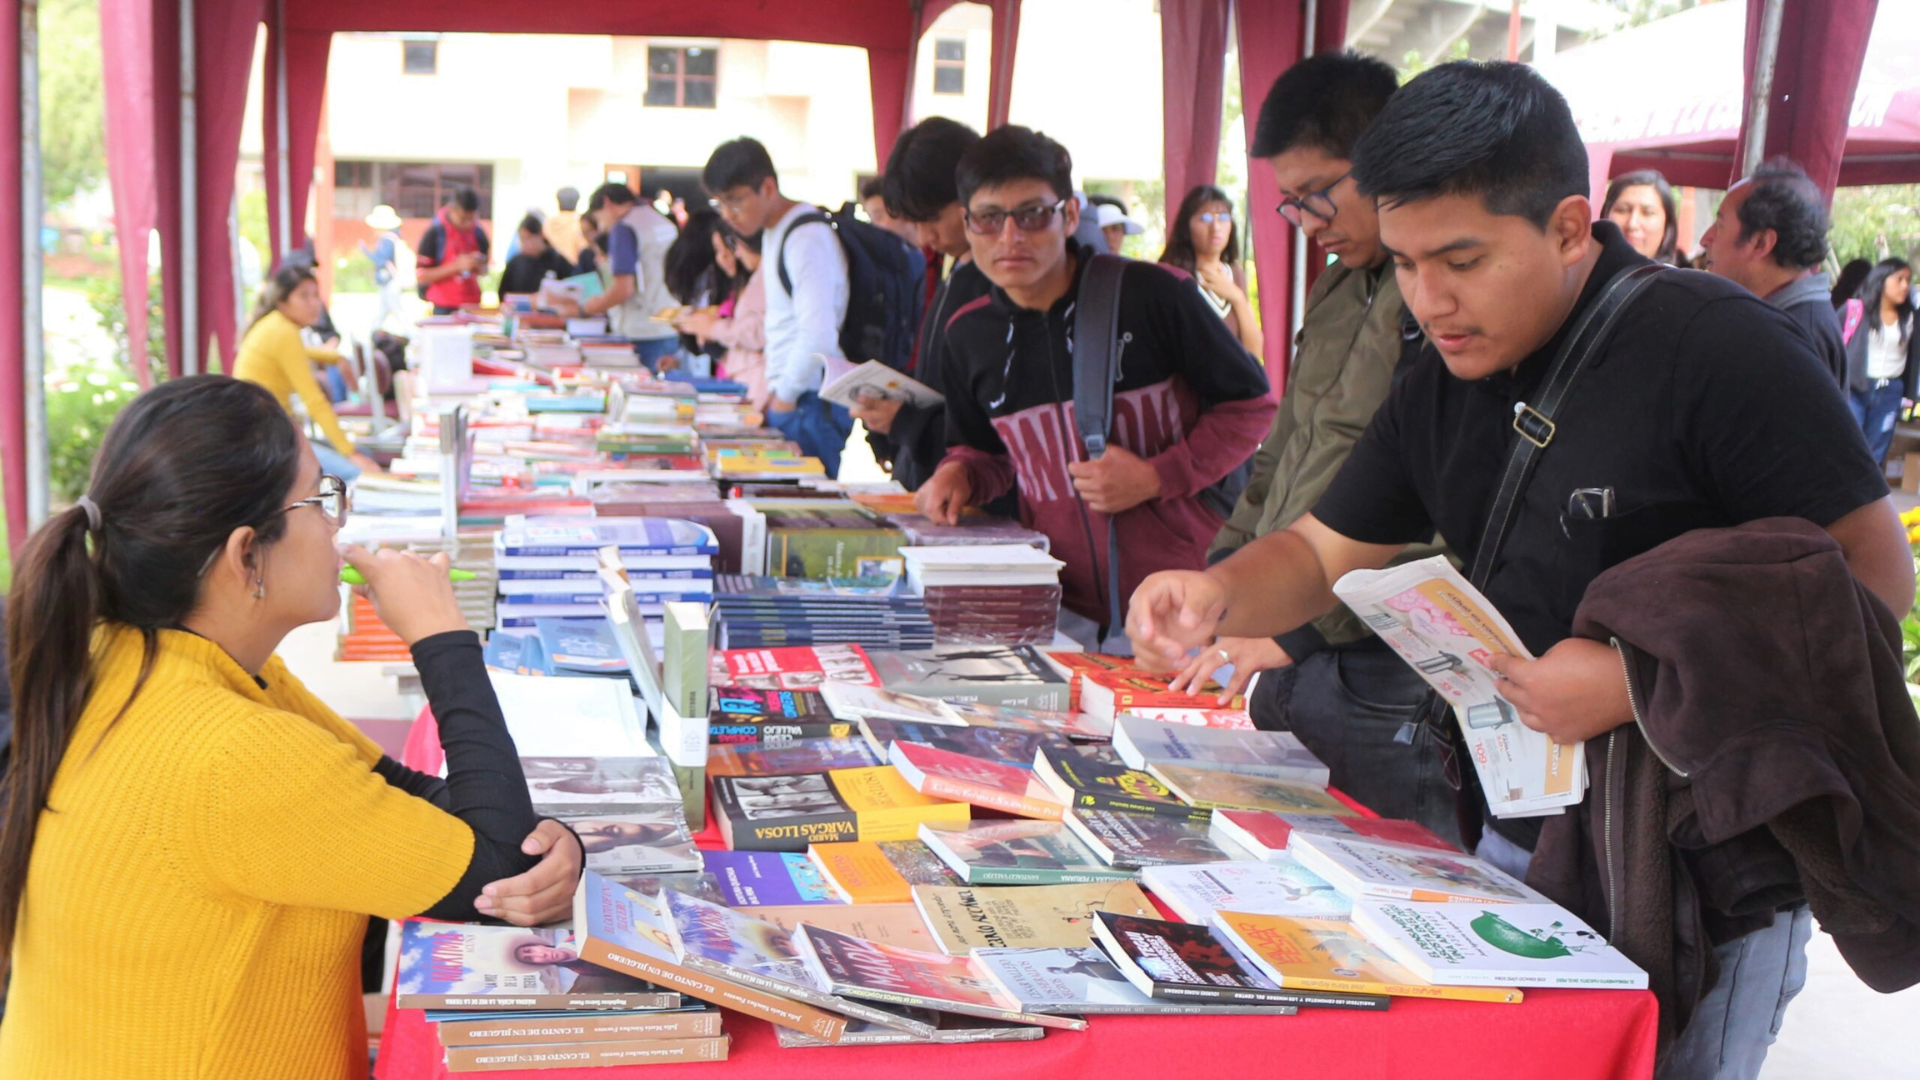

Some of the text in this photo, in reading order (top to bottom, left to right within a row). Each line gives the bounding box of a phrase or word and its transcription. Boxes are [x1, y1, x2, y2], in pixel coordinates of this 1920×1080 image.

[709, 726, 756, 734] COMPLETA
[763, 726, 802, 734] VALLEJO
[754, 825, 798, 839] LLOSA
[800, 821, 854, 835] VARGAS
[607, 950, 714, 993] EL CANTO DE UN JILGUERO
[722, 991, 746, 1003] Fuentes
[786, 1011, 801, 1022] Julia
[468, 1028, 511, 1037] JILGUERO
[475, 1054, 517, 1062] JILGUERO
[547, 1052, 577, 1060] CANTO
